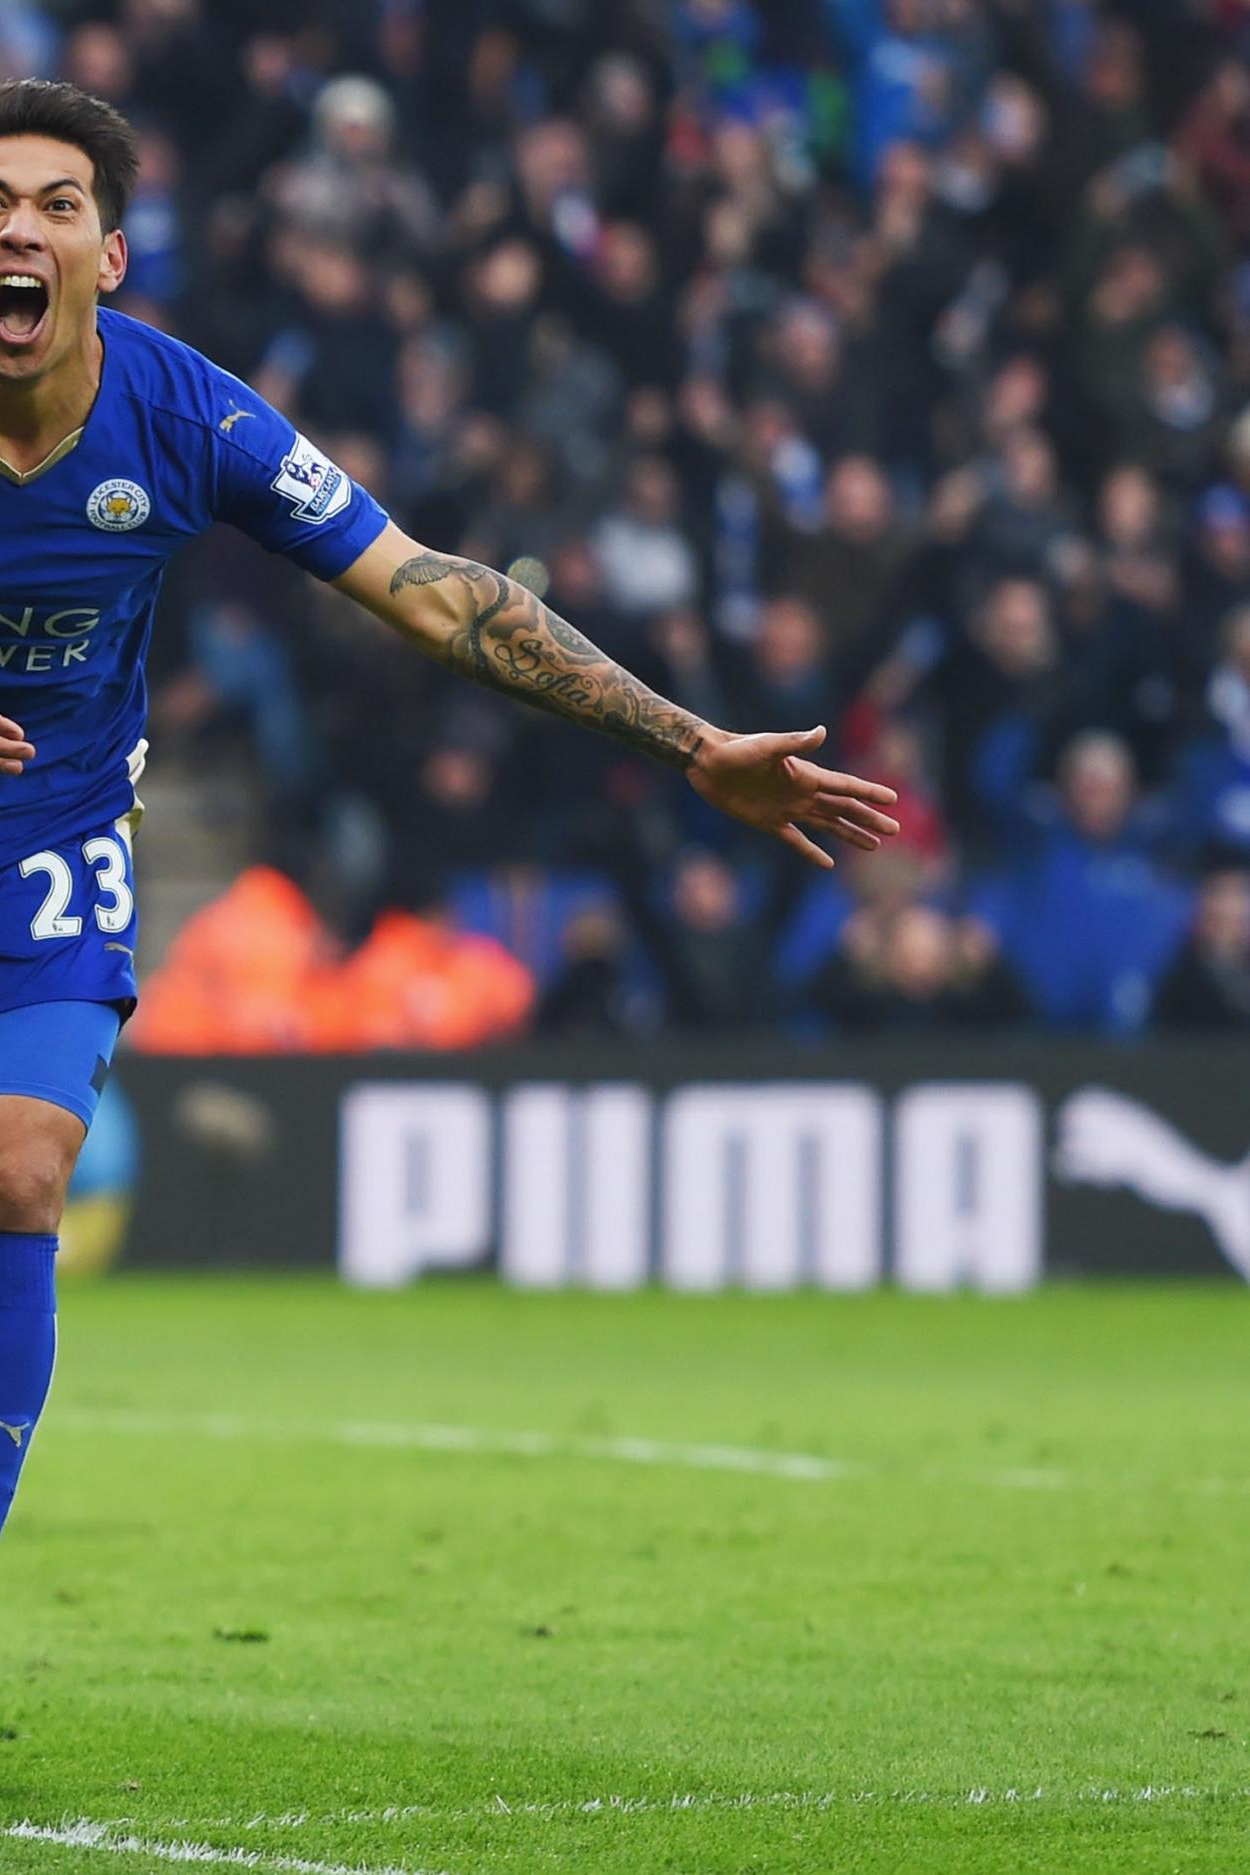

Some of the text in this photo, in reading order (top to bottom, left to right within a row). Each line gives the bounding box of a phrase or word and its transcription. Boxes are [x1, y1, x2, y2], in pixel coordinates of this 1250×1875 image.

[90, 482, 148, 508] LEICESTER CITY
[19, 836, 133, 941] 23
[340, 1083, 1042, 1293] PUMA
